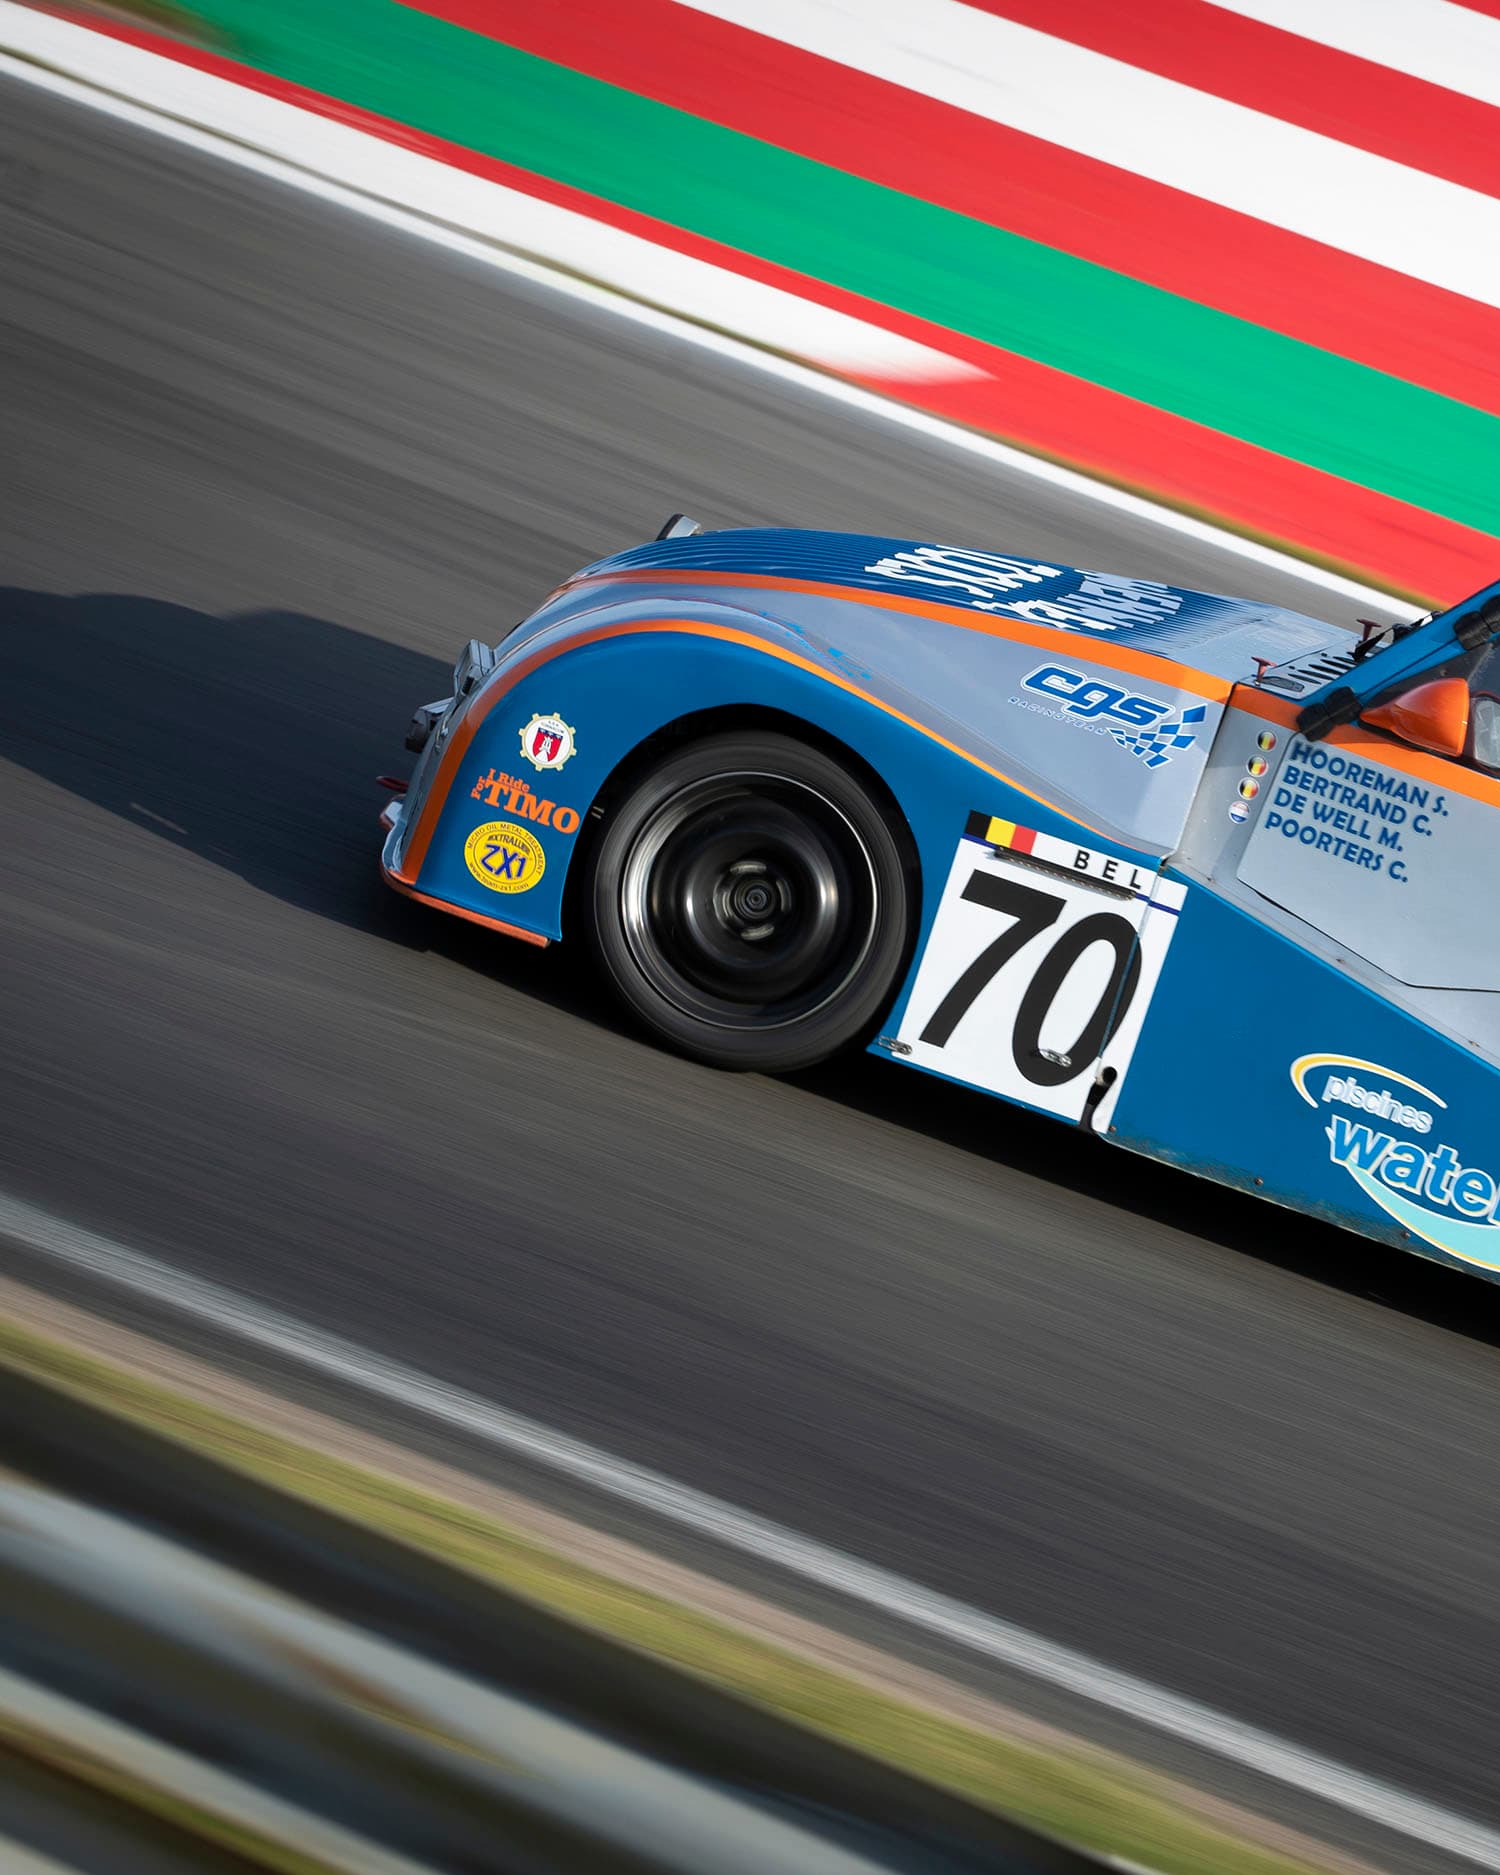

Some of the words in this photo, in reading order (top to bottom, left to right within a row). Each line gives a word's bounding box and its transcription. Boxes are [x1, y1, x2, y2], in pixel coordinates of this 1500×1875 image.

[1021, 663, 1175, 729] cgs
[483, 780, 581, 835] TIMO
[499, 772, 531, 793] Ride
[1282, 765, 1407, 825] BERTRAND
[1412, 814, 1433, 837] C.
[1290, 741, 1430, 808] HOOREMAN
[1432, 795, 1450, 817] S.
[1264, 811, 1385, 872] POORTERS
[1388, 860, 1409, 883] C.
[1273, 788, 1307, 814] DE
[1312, 800, 1372, 840] WELL
[1378, 826, 1404, 852] M.
[481, 844, 526, 879] ZX1
[1073, 850, 1143, 890] BEL
[919, 868, 1143, 1087] 70
[1321, 1074, 1434, 1135] piscines
